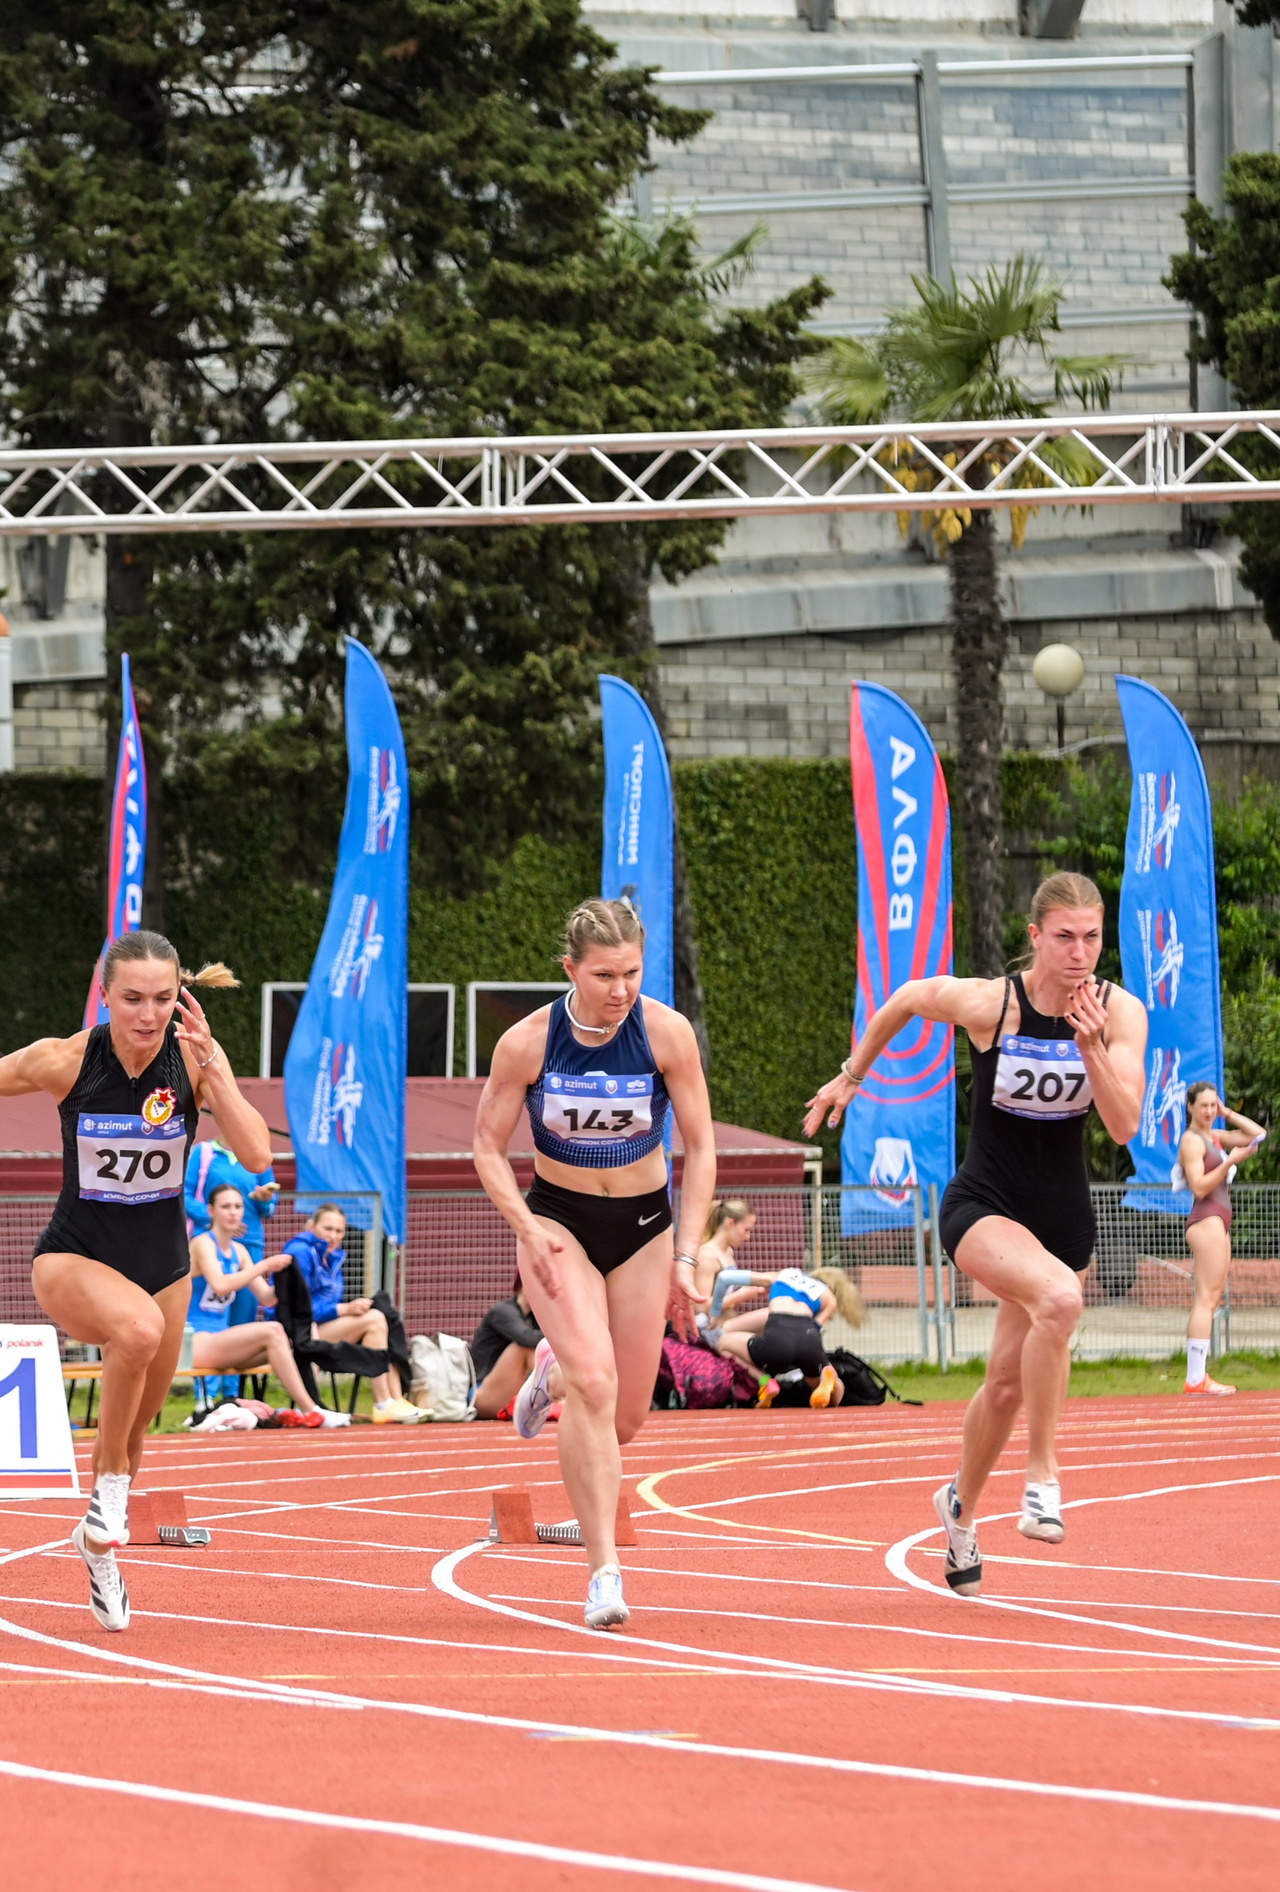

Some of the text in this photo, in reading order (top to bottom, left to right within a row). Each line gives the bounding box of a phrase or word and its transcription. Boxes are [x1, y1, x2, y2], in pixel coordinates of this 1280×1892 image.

[889, 735, 918, 931] ВФЛА
[564, 1080, 597, 1090] azimut
[1010, 1069, 1086, 1103] 207
[97, 1121, 133, 1131] azimut
[563, 1108, 634, 1132] 143
[95, 1149, 171, 1183] 270
